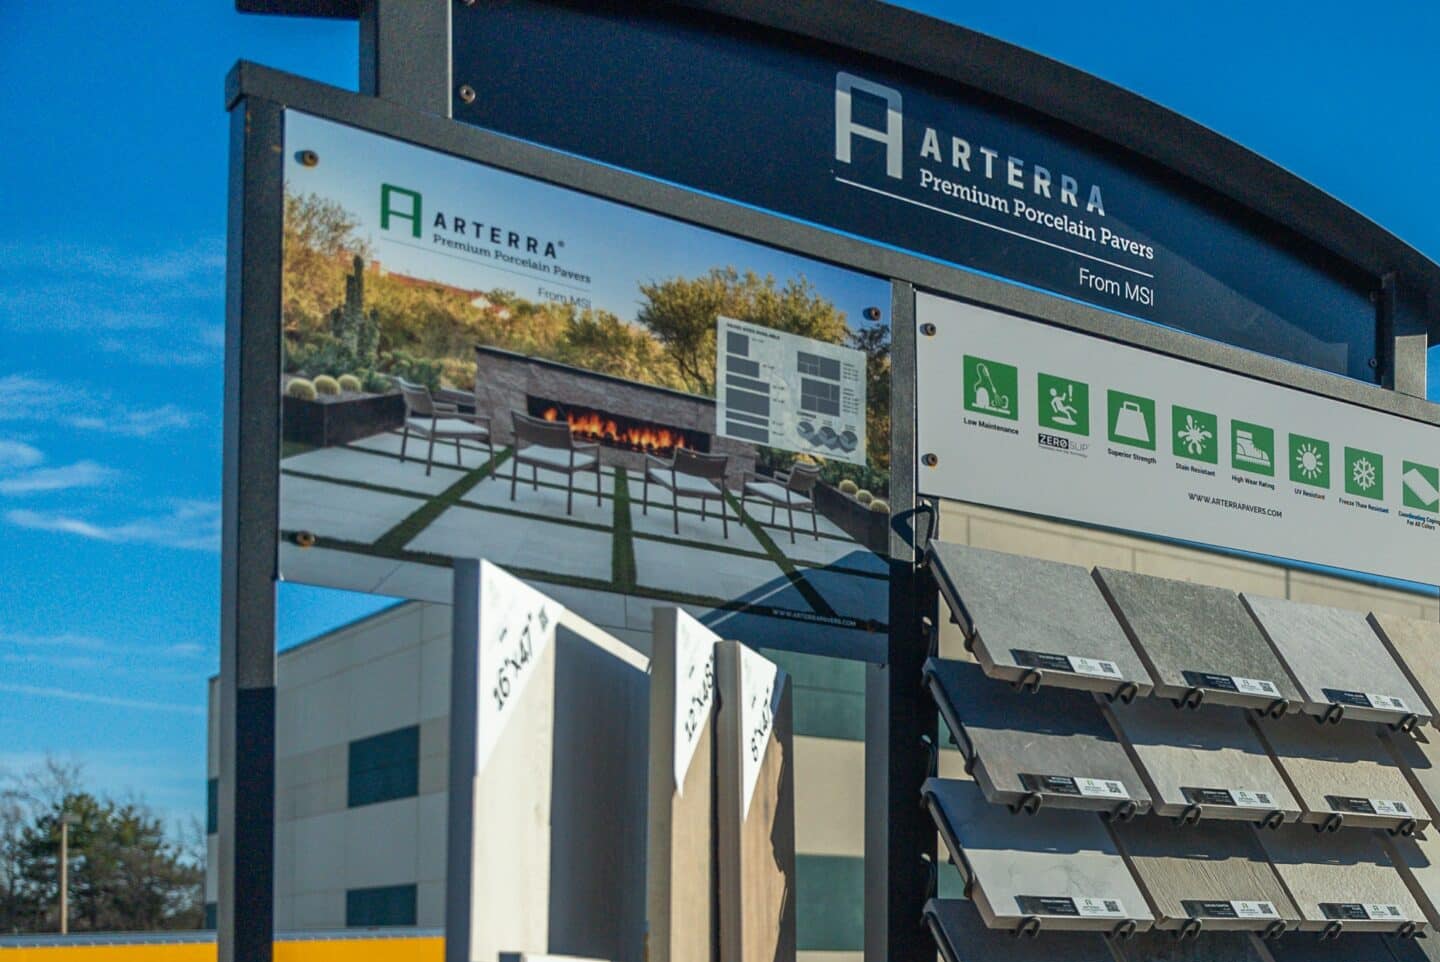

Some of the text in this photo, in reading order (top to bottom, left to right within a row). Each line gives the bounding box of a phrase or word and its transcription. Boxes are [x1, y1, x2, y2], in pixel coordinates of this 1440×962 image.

[920, 127, 1105, 216] ARTERRA
[920, 169, 1154, 260] Premium Porcelain Pavers
[434, 212, 557, 259] ARTERRA
[433, 233, 591, 284] Premium Porcelain Pavers
[537, 287, 567, 304] From
[1079, 267, 1154, 306] From MSI
[963, 417, 1019, 435] Low Maintenance
[1108, 448, 1157, 464] Superior Strength
[1175, 463, 1189, 471] Stain
[1231, 474, 1243, 483] High
[1294, 488, 1302, 496] UV
[1188, 492, 1282, 518] WWW.ARTERRAPAVERS.COM
